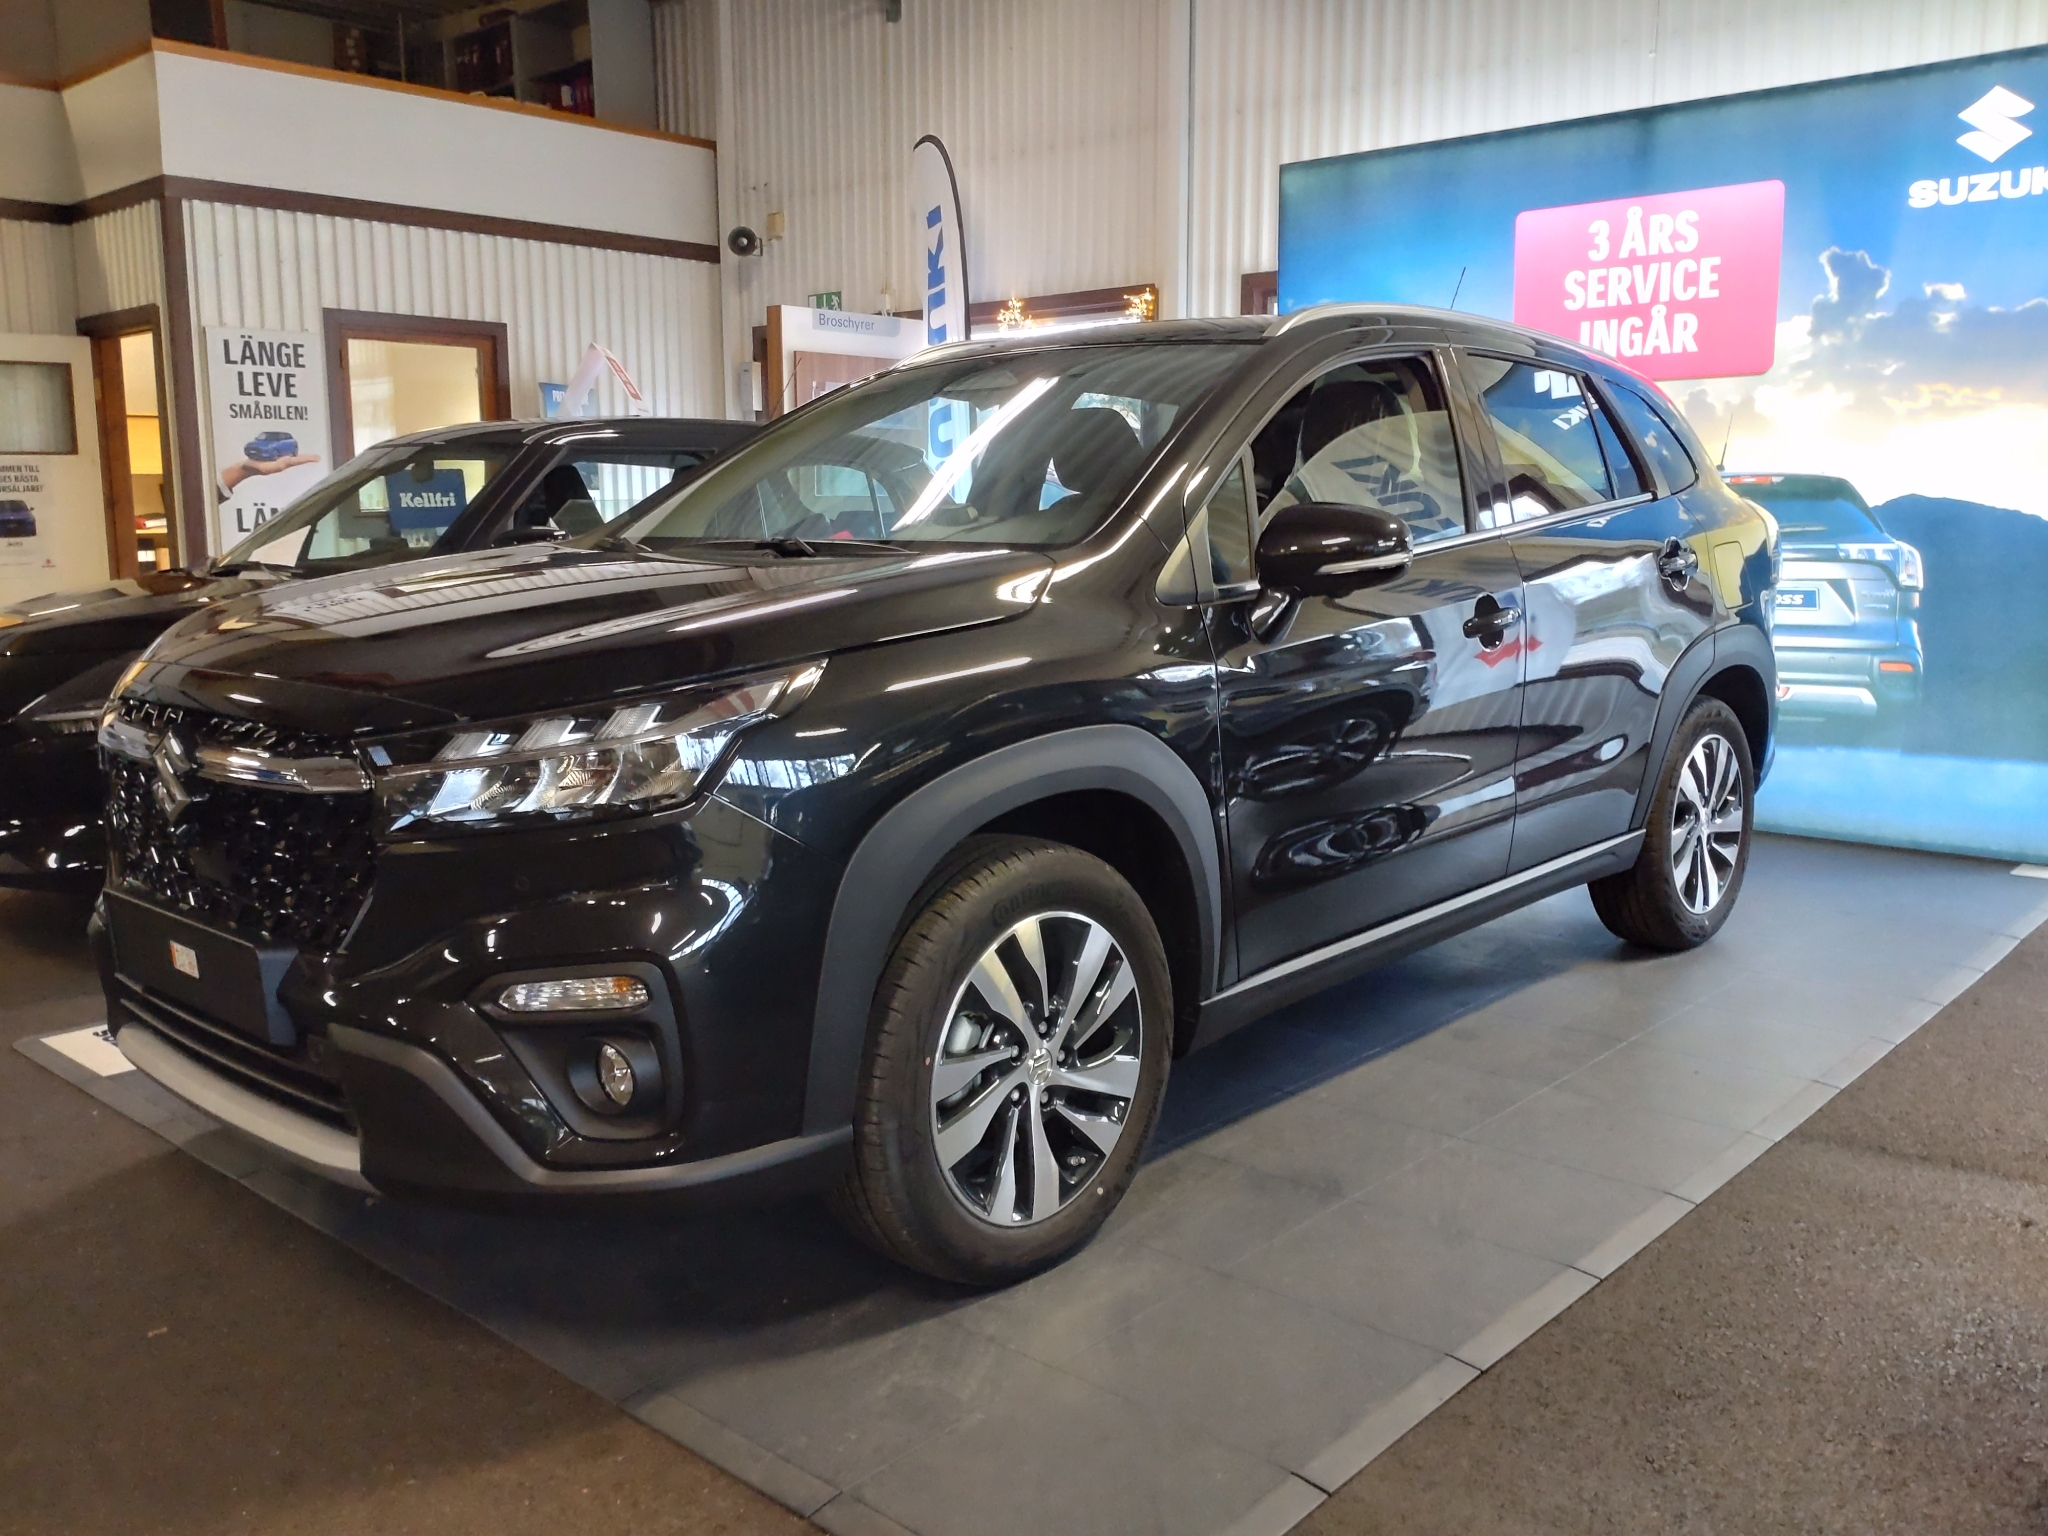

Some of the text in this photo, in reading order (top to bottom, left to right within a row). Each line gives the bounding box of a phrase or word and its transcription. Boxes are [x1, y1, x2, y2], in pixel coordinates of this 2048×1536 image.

[1588, 205, 1700, 262] 3 ÅRS
[1563, 256, 1722, 311] SERVICE
[818, 313, 875, 332] Broschyrer
[1580, 304, 1699, 358] INGÅR
[223, 334, 306, 368] LÄNGE
[237, 371, 298, 398] LEVE
[229, 400, 309, 420] SMÅBILEN!
[399, 492, 456, 508] Kellfri
